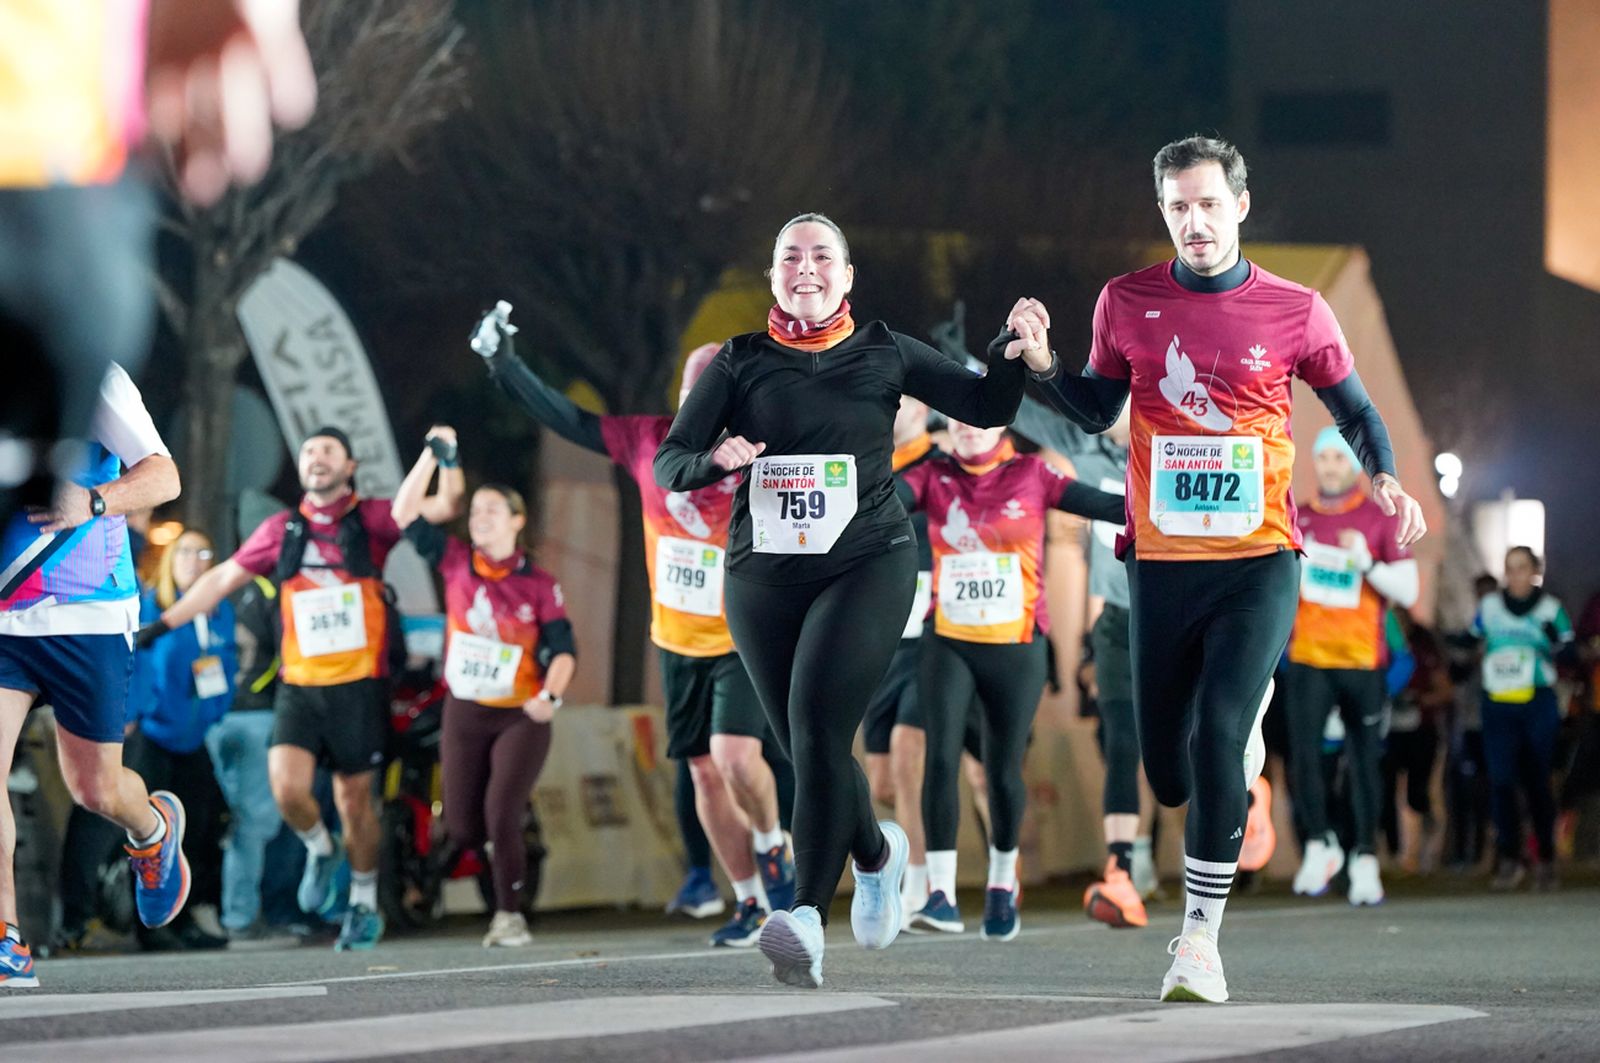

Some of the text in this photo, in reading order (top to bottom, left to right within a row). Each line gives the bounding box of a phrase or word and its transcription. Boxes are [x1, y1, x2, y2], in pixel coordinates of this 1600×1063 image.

[1180, 391, 1208, 416] 43
[1164, 460, 1185, 469] SAN
[1187, 457, 1222, 469] ANTÓN
[1177, 448, 1222, 457] NOCHE DE
[762, 479, 778, 489] SAN
[781, 476, 815, 488] ANTÓN
[770, 466, 800, 476] NOCHE
[803, 466, 814, 476] DE
[1175, 472, 1240, 501] 8472
[778, 490, 826, 520] 759
[666, 564, 706, 589] 2799
[955, 578, 1006, 601] 2802
